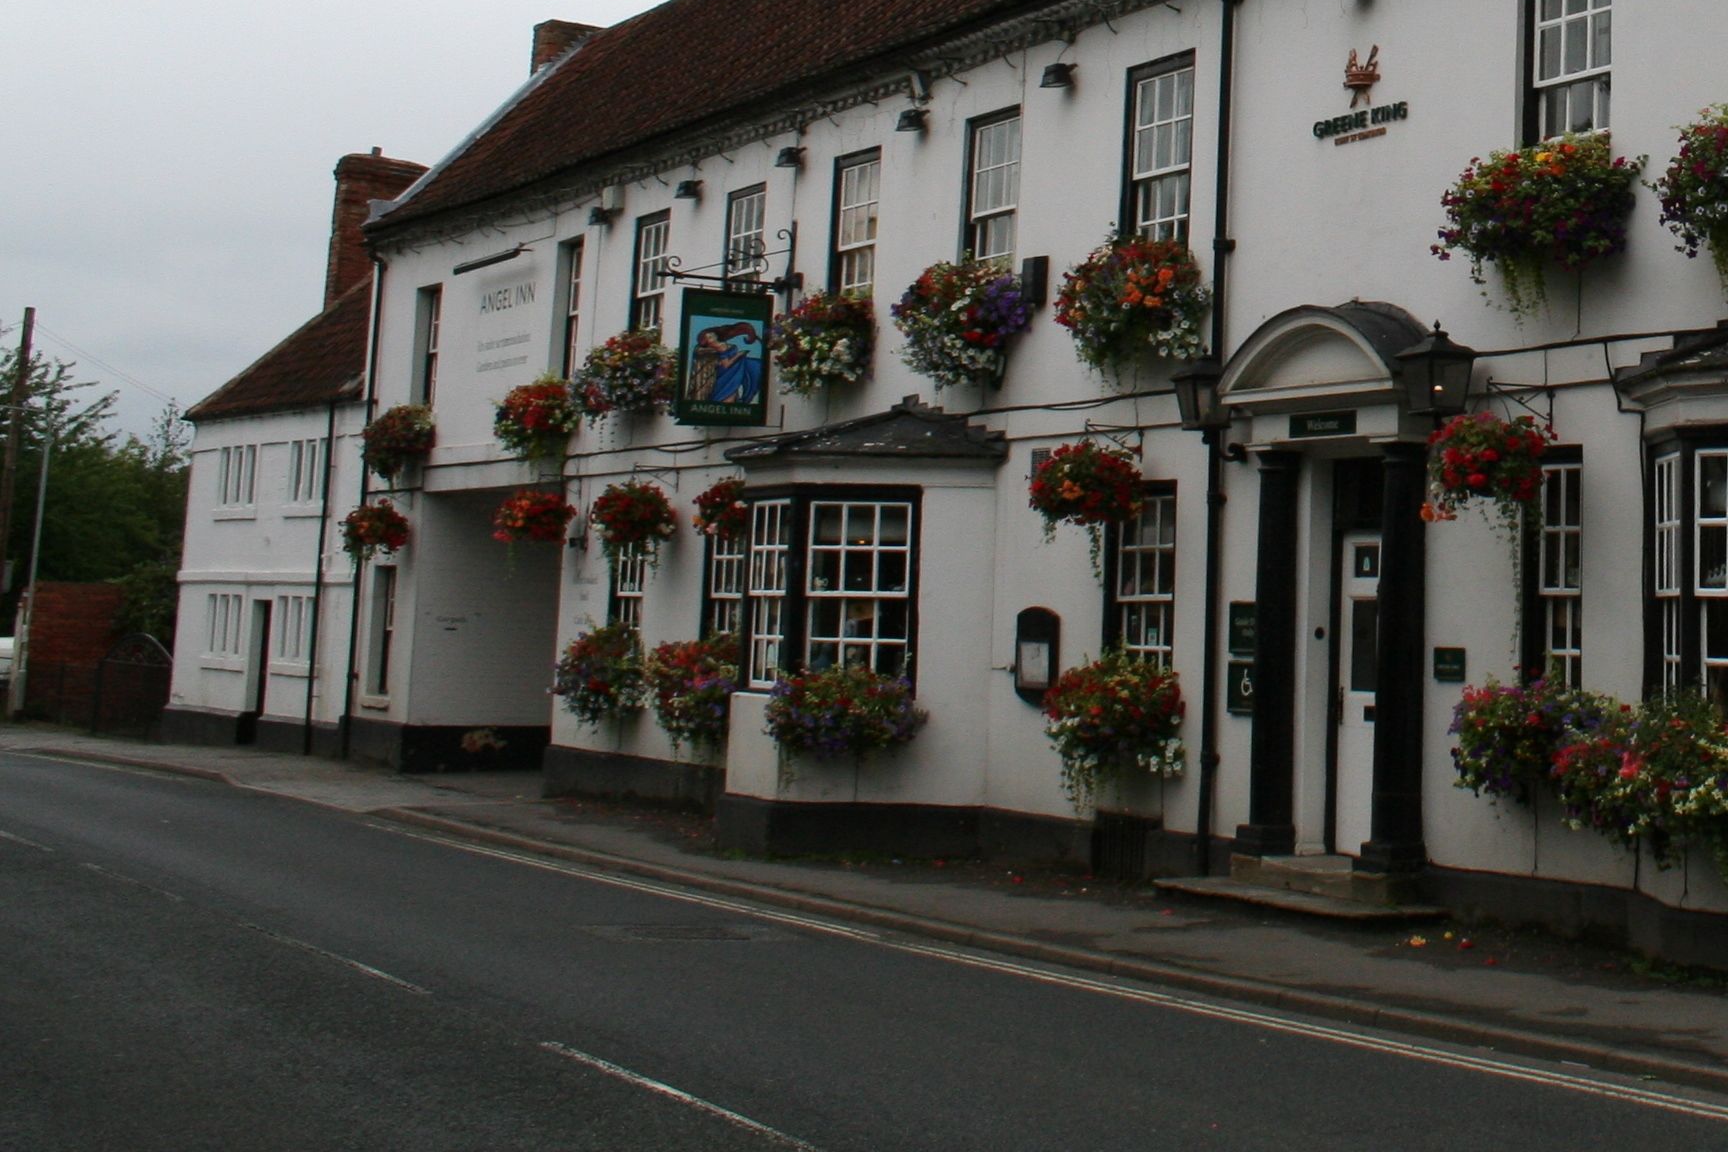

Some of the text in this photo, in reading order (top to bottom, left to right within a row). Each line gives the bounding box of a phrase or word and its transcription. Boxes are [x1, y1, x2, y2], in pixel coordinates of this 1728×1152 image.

[1313, 110, 1368, 139] GREENE
[1370, 101, 1408, 125] KING
[480, 282, 536, 314] ANGEL INN
[690, 403, 752, 416] ANGEL INN
